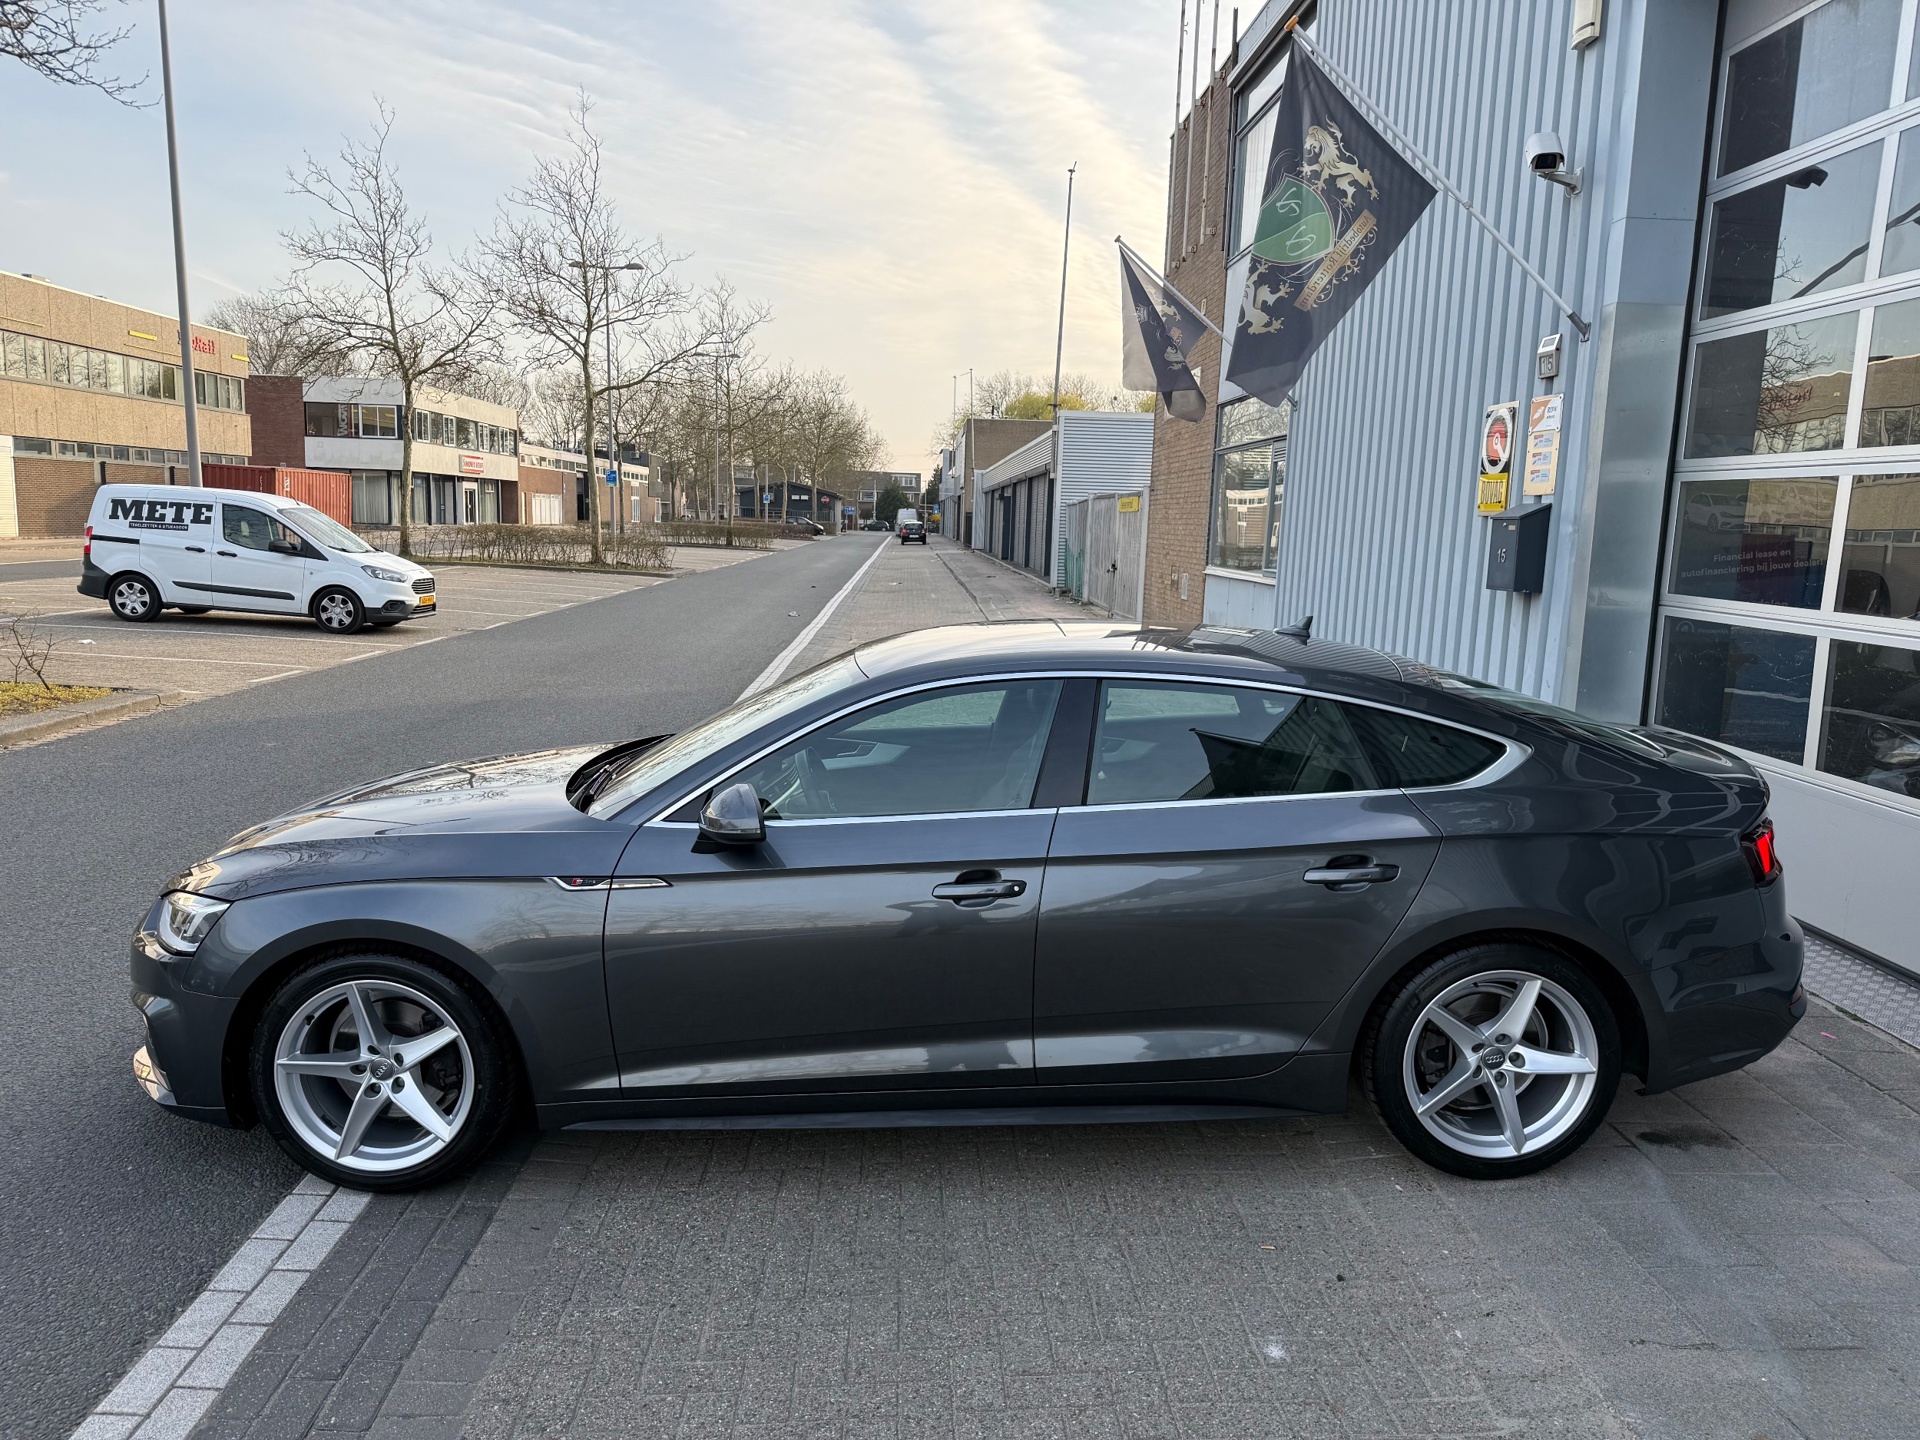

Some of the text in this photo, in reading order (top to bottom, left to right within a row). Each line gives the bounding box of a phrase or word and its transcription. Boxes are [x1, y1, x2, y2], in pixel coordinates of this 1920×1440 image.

[1541, 356, 1553, 372] 15
[1481, 480, 1504, 505] BOVAG
[109, 499, 214, 525] METE
[1497, 548, 1507, 563] 15
[1713, 550, 1754, 562] Financial
[1755, 550, 1778, 558] lease
[1681, 558, 1824, 578] autofinanciering bij jouw dealer!
